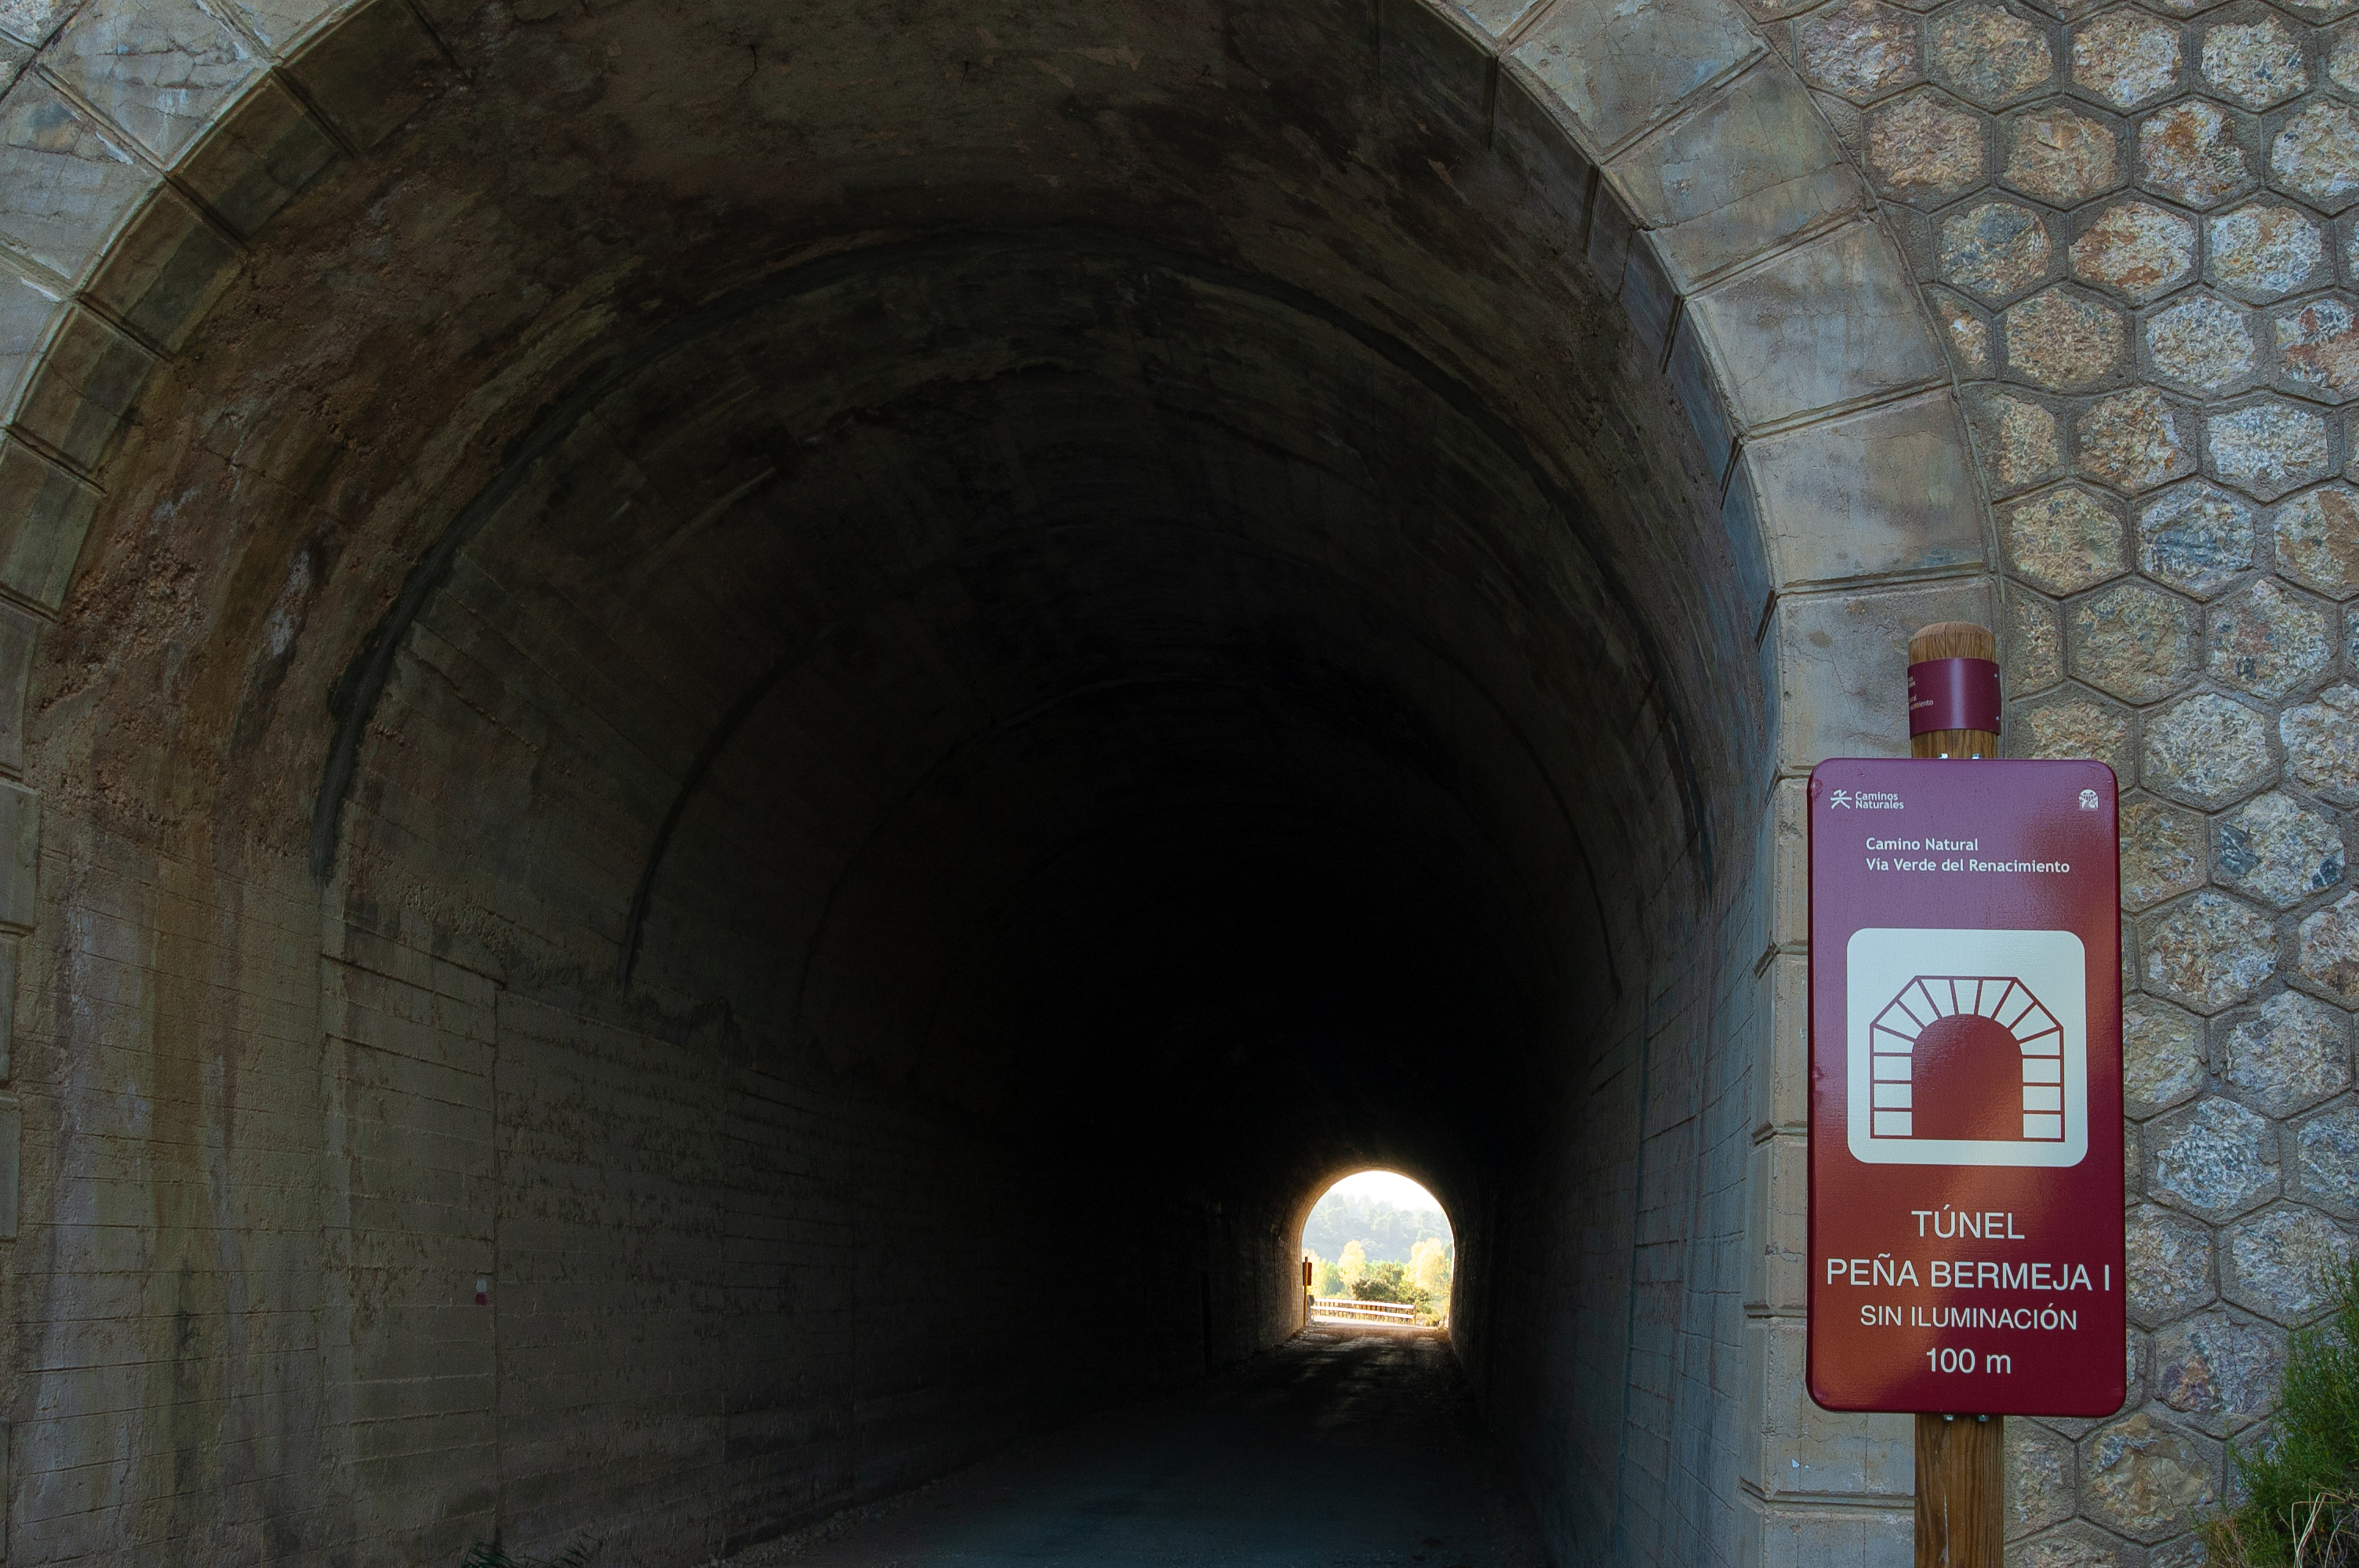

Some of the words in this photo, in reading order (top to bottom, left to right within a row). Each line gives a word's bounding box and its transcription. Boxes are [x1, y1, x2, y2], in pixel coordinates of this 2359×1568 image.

[1855, 790, 1899, 800] Caminos
[1855, 800, 1905, 810] Naturales
[1866, 837, 1921, 851] Camino
[1925, 837, 1979, 851] Natural
[1866, 857, 1889, 871] Vía
[1893, 858, 1937, 872] Verde
[1941, 858, 1965, 872] del
[1968, 858, 2070, 873] Renacimiento
[1910, 1203, 2025, 1240] TÚNEL
[1827, 1252, 1920, 1287] PEÑA
[1931, 1260, 2093, 1291] BERMEJA
[2104, 1264, 2110, 1291] I
[1860, 1305, 1902, 1327] SIN
[1911, 1302, 2077, 1330] ILUMINACIÓN
[1926, 1347, 1976, 1374] 100
[1986, 1354, 2011, 1374] m
